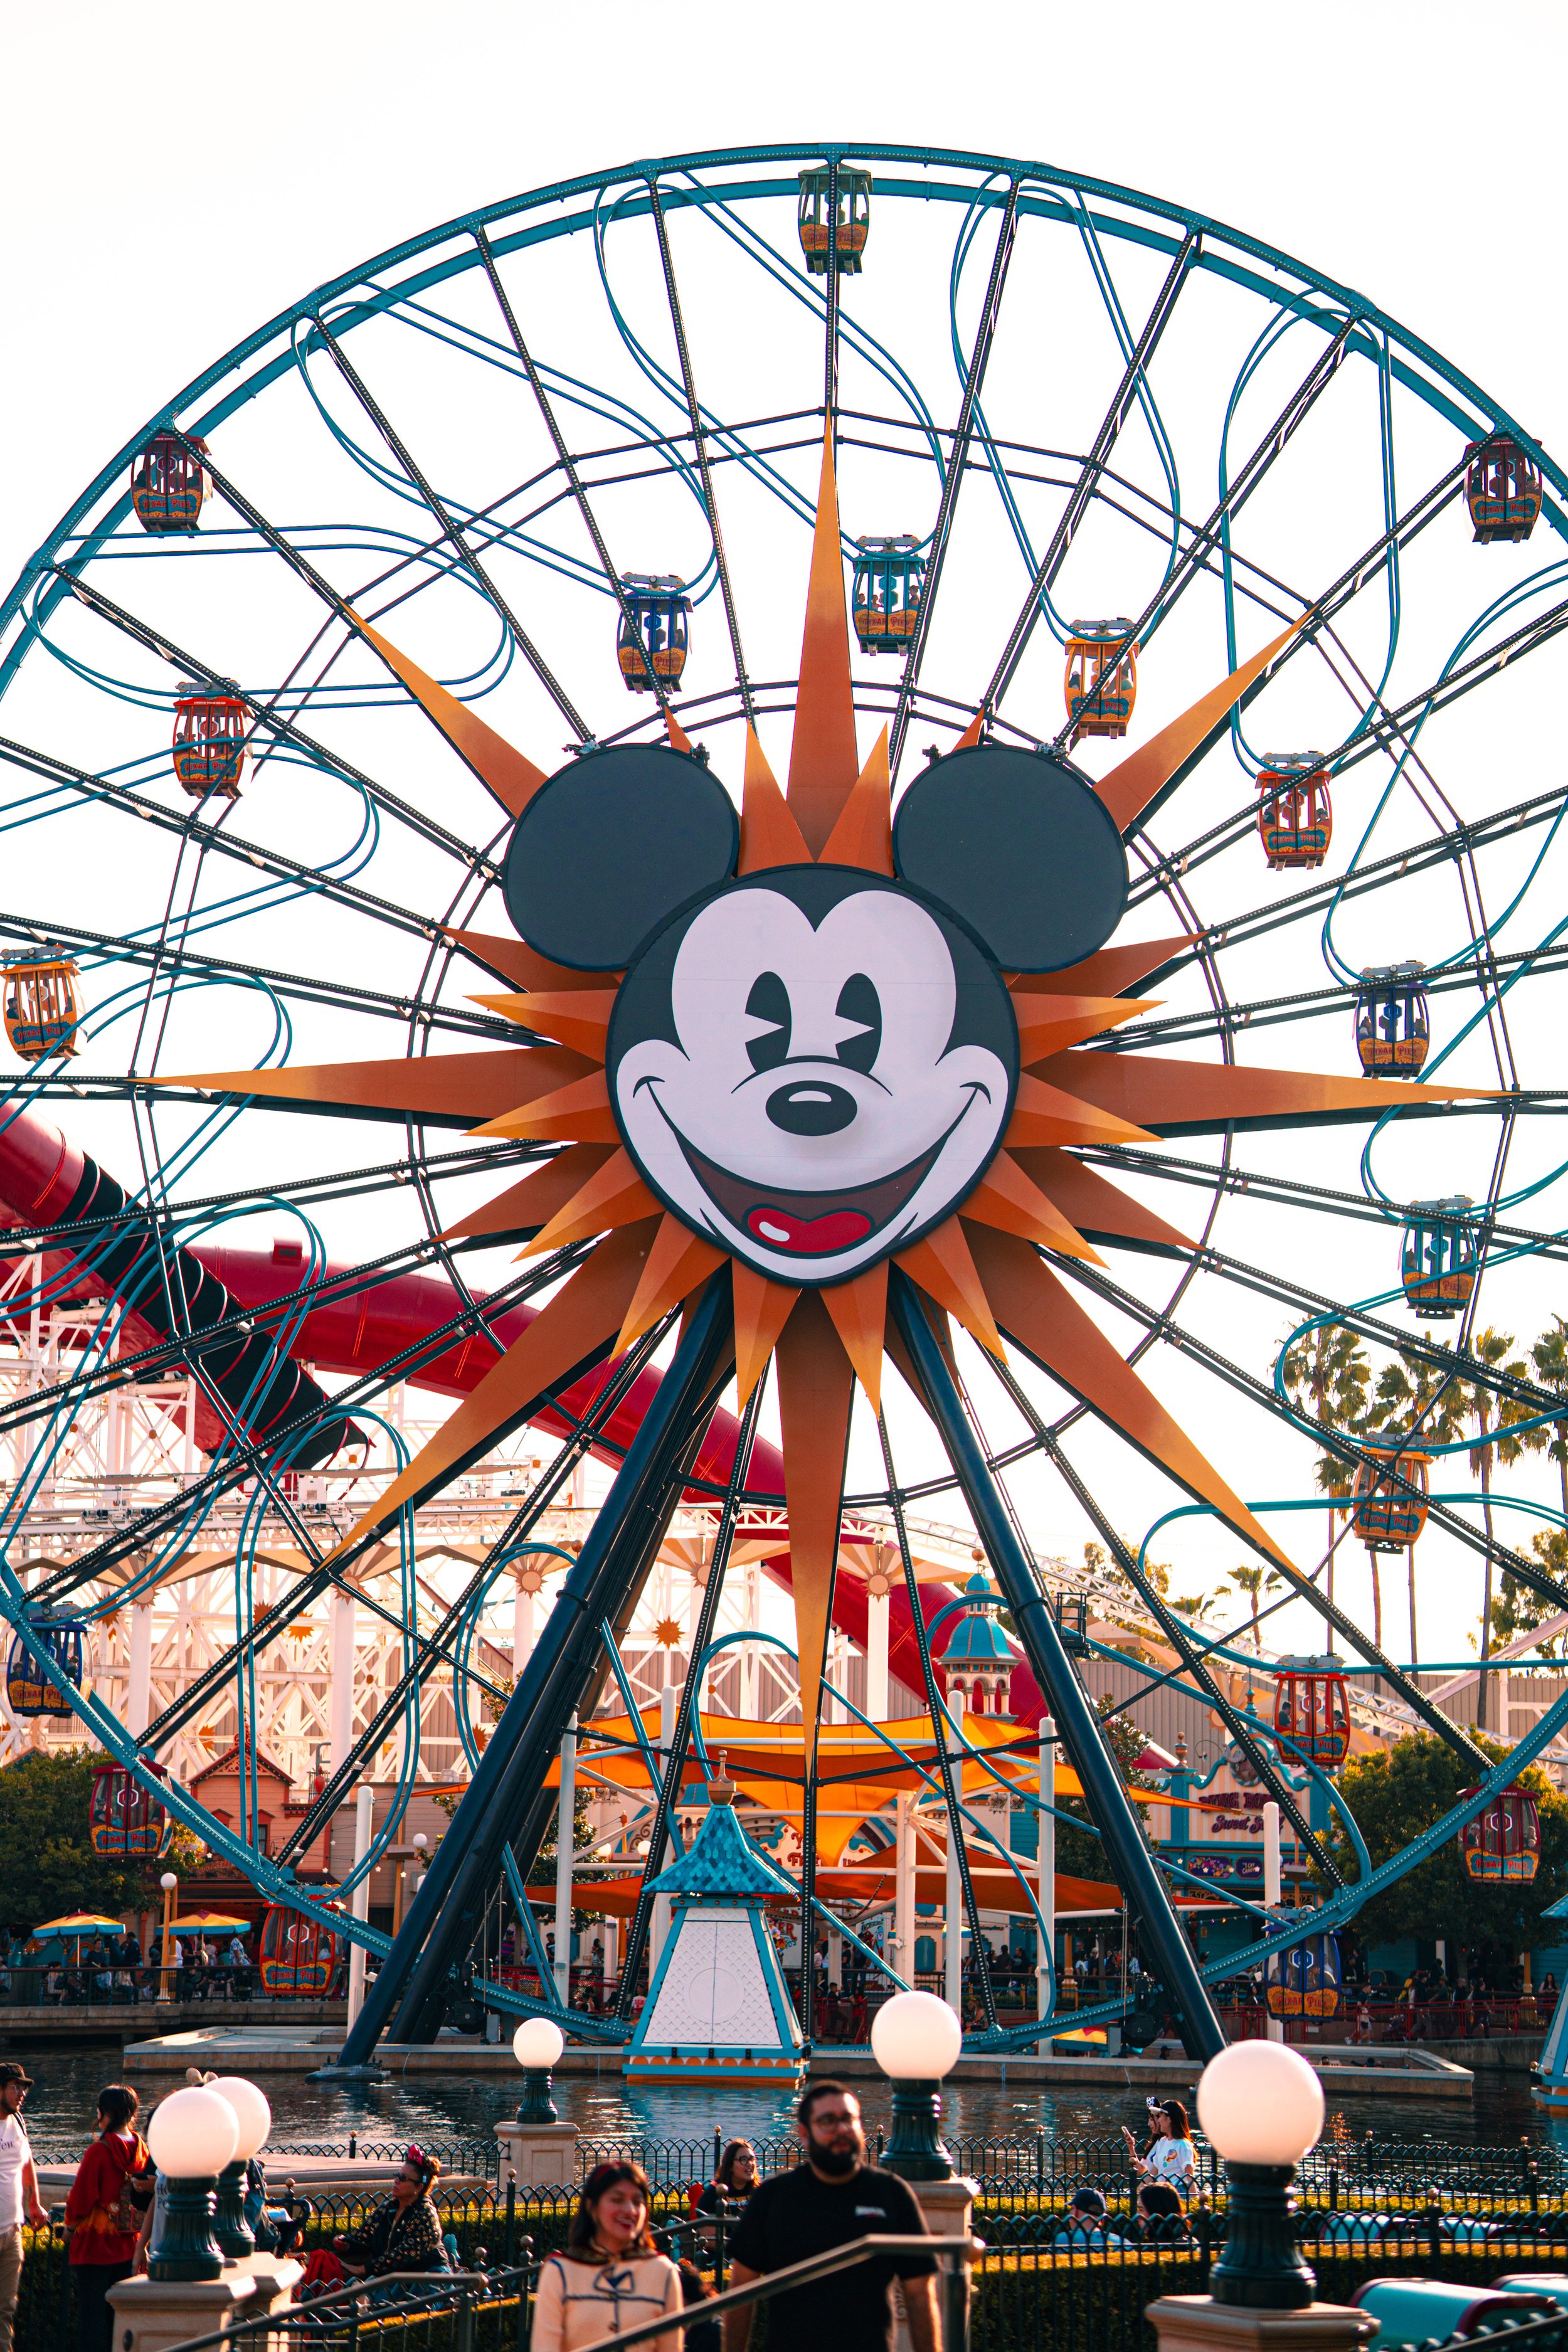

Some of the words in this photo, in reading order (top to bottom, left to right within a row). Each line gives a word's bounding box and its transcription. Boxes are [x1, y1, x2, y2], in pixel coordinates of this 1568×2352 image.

[837, 231, 857, 243] PIER
[142, 499, 166, 510] PIXAR
[171, 498, 193, 510] PIER
[1480, 506, 1504, 516] PIXAR
[1510, 503, 1530, 514] PIER
[862, 618, 885, 627] PIXAR
[891, 617, 911, 629] PIER
[655, 656, 674, 667] PIER
[1104, 701, 1124, 713] PIER
[184, 763, 207, 773] PIXAR
[1272, 835, 1295, 845] PIXAR
[1300, 834, 1322, 844] PIER
[18, 1029, 41, 1041] PIXAR
[1369, 1048, 1392, 1058] PIXAR
[1397, 1046, 1417, 1058] PIER
[1364, 1513, 1388, 1523] PIXAR
[1393, 1517, 1414, 1529] PIER
[18, 1690, 41, 1700] PIXAR
[1317, 1740, 1338, 1752] PIER
[1212, 1814, 1250, 1833] Sweet
[101, 1835, 125, 1846] PIXAR
[130, 1834, 152, 1845] PIER
[1475, 1859, 1501, 1870] PIXAR
[1507, 1860, 1529, 1872] PIER
[271, 1971, 295, 1981] PIXAR
[300, 1970, 320, 1982] PIER
[1276, 1997, 1302, 2006] PIXAR
[1306, 1996, 1329, 2008] PIER
